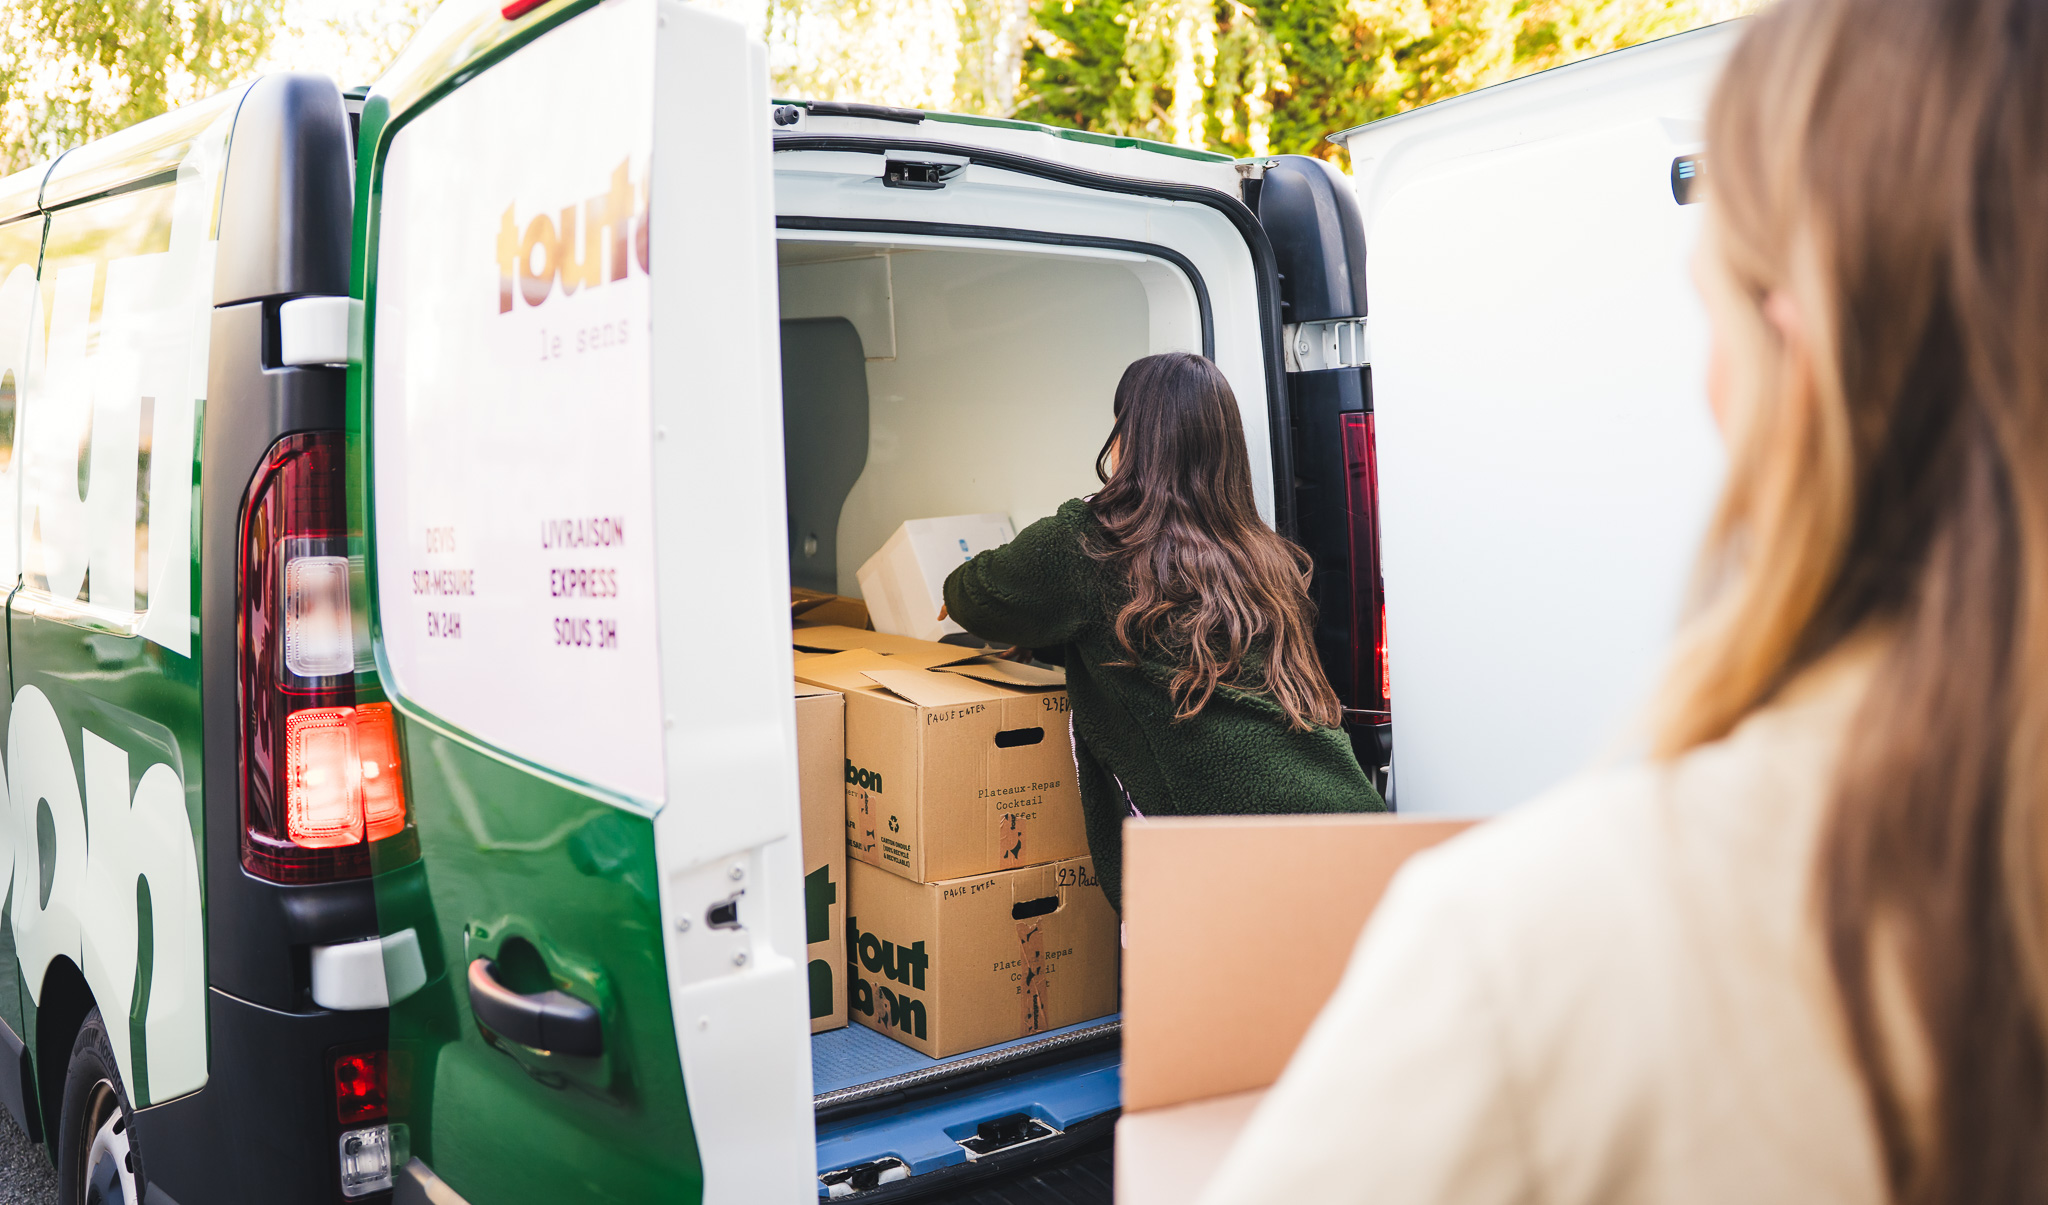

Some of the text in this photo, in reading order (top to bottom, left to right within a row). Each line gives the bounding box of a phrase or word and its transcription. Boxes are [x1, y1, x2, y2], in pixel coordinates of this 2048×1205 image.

[540, 319, 628, 361] le sens
[426, 526, 455, 553] DEVIS
[541, 516, 624, 549] LIVRAISON
[412, 569, 475, 596] SUR-MESURE
[551, 568, 617, 598] EXPRESS
[428, 611, 461, 639] EN 24H
[554, 617, 617, 649] SOUS 3H
[927, 710, 956, 726] PAUSE
[978, 780, 1061, 799] Plateaux-Repas
[996, 795, 1043, 811] Cocktail
[880, 836, 895, 846] CARTON
[847, 916, 929, 991] tout
